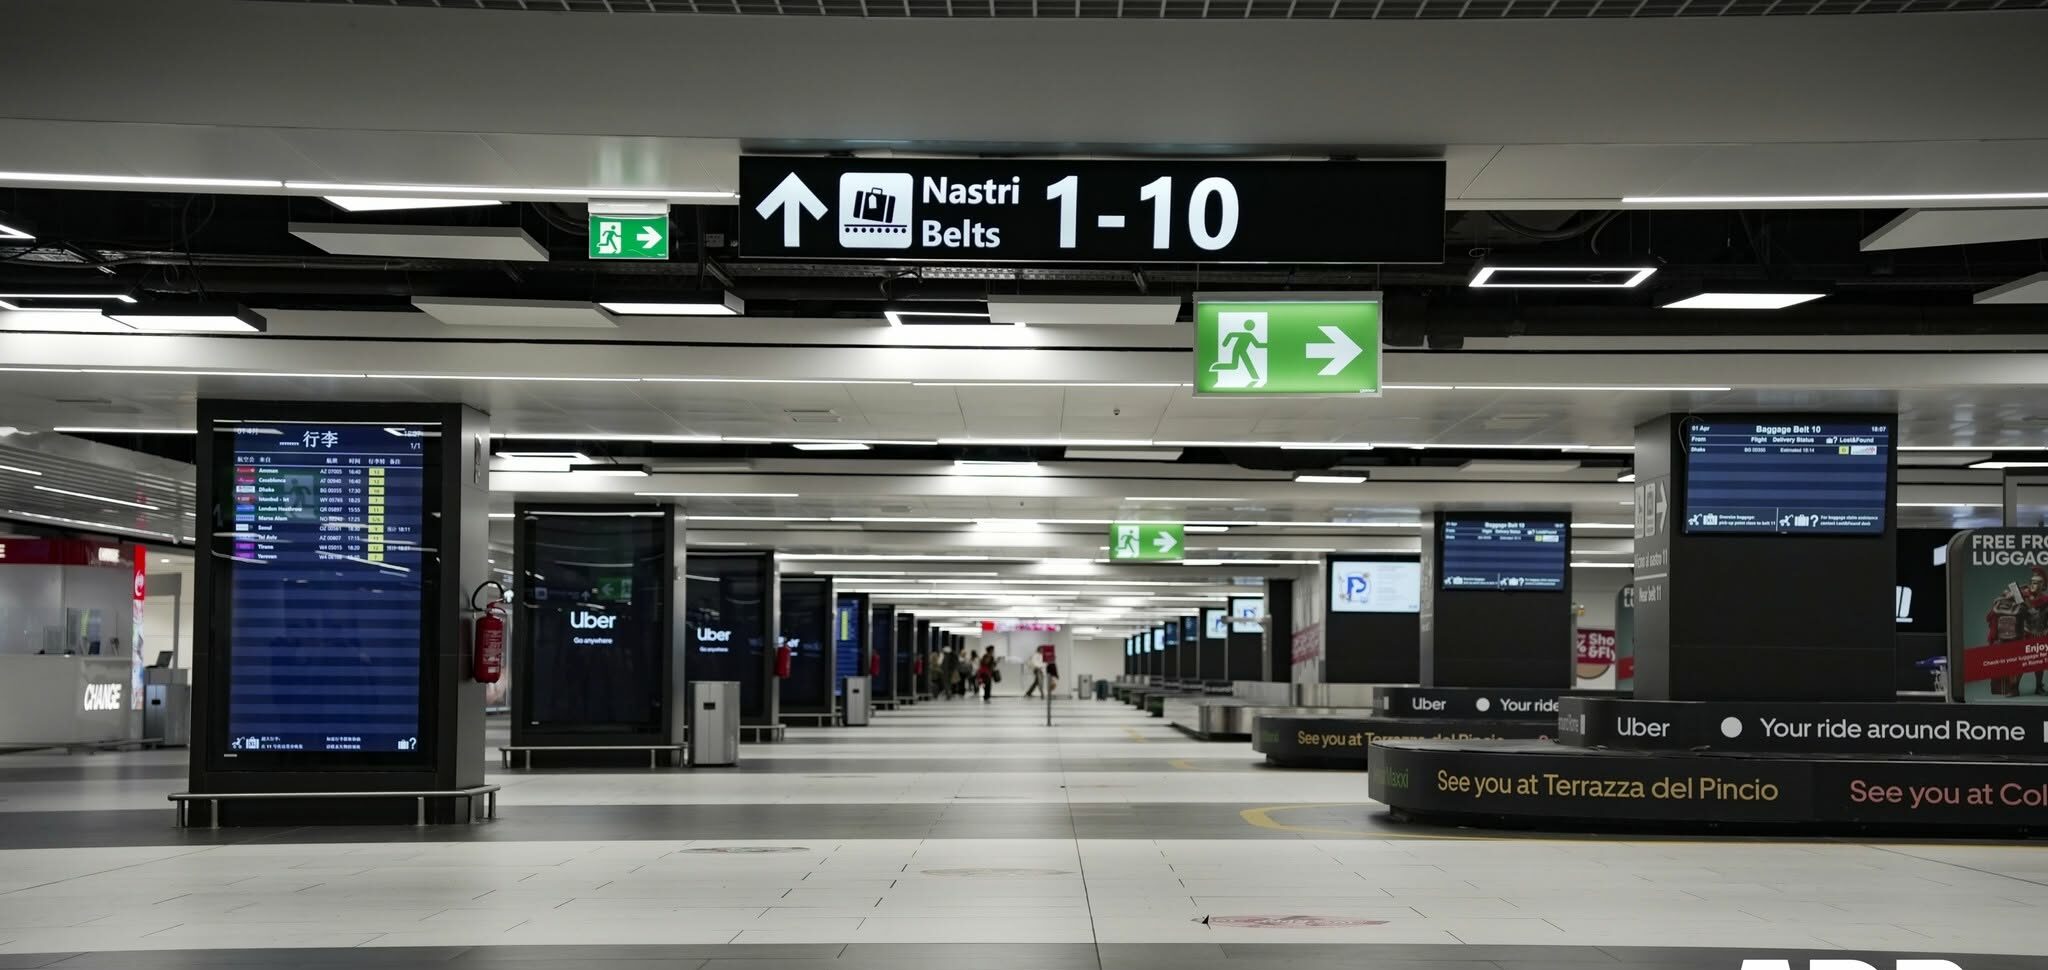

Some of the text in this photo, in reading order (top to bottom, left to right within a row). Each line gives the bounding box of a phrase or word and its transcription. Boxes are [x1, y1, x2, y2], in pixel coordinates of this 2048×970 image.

[923, 176, 1020, 204] Nastri
[1047, 175, 1239, 250] 1-10
[923, 219, 1001, 249] Belts
[1756, 425, 1791, 434] Baggage
[303, 431, 339, 448] 行李
[410, 442, 421, 450] 1/1
[1972, 535, 2015, 550] FREE
[570, 611, 617, 629] Uber
[573, 637, 613, 645] Go anywhere
[697, 628, 731, 642] Uber
[84, 683, 122, 711] CHANGE
[1412, 698, 1447, 711] Uber
[1500, 698, 1531, 712] Your
[1617, 716, 2025, 741] Uber Your ride around Rome
[1297, 730, 1320, 744] See
[1321, 734, 1347, 748] you
[1348, 733, 1362, 745] at
[1437, 770, 1779, 801] See you at Terrazza del Pincio
[1850, 780, 2048, 809] See you at Col
